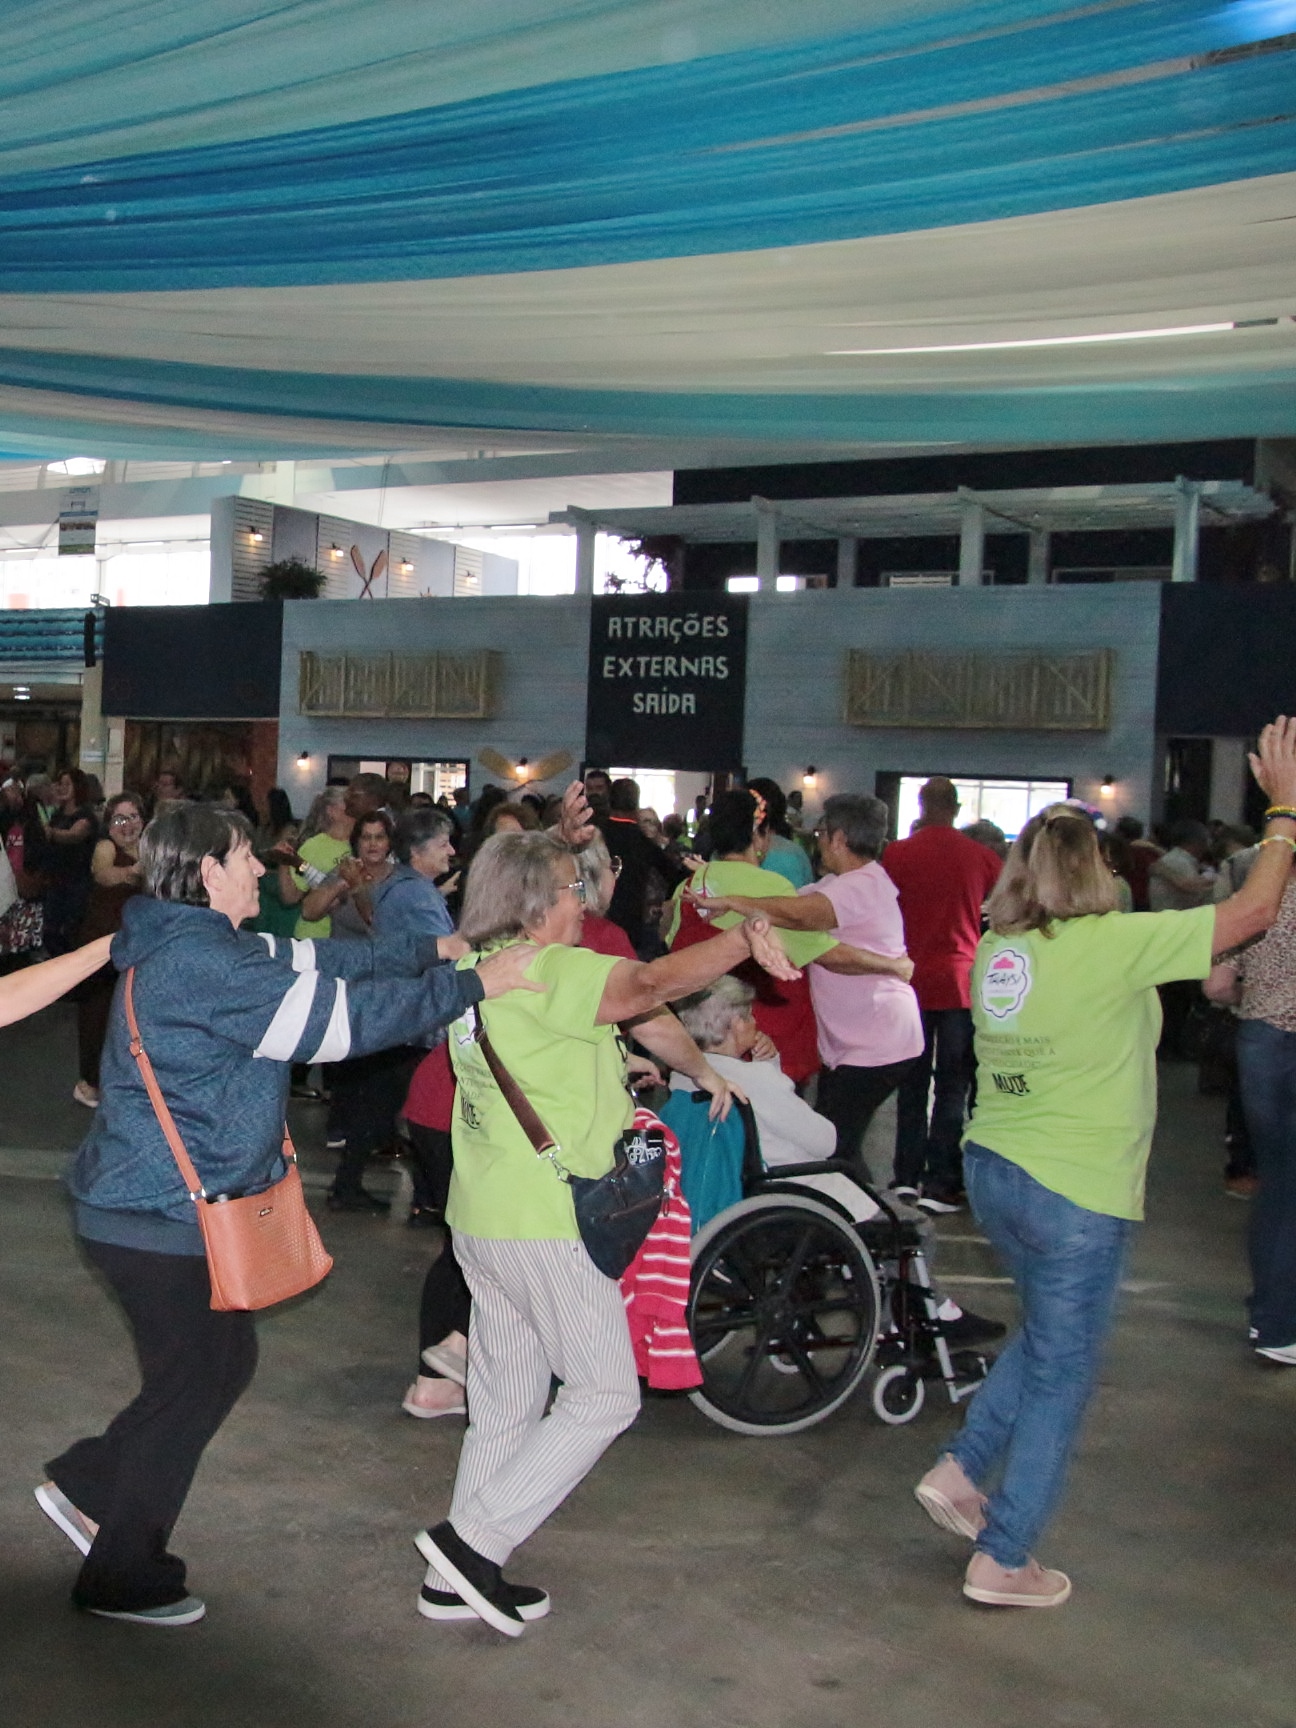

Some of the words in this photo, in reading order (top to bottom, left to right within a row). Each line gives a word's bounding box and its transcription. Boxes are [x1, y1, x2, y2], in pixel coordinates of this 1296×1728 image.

[608, 612, 729, 644] ATRAÇÕES
[603, 655, 729, 679] EXTERNAS
[633, 686, 696, 715] SAÍDA
[992, 1072, 1031, 1096] MUDE
